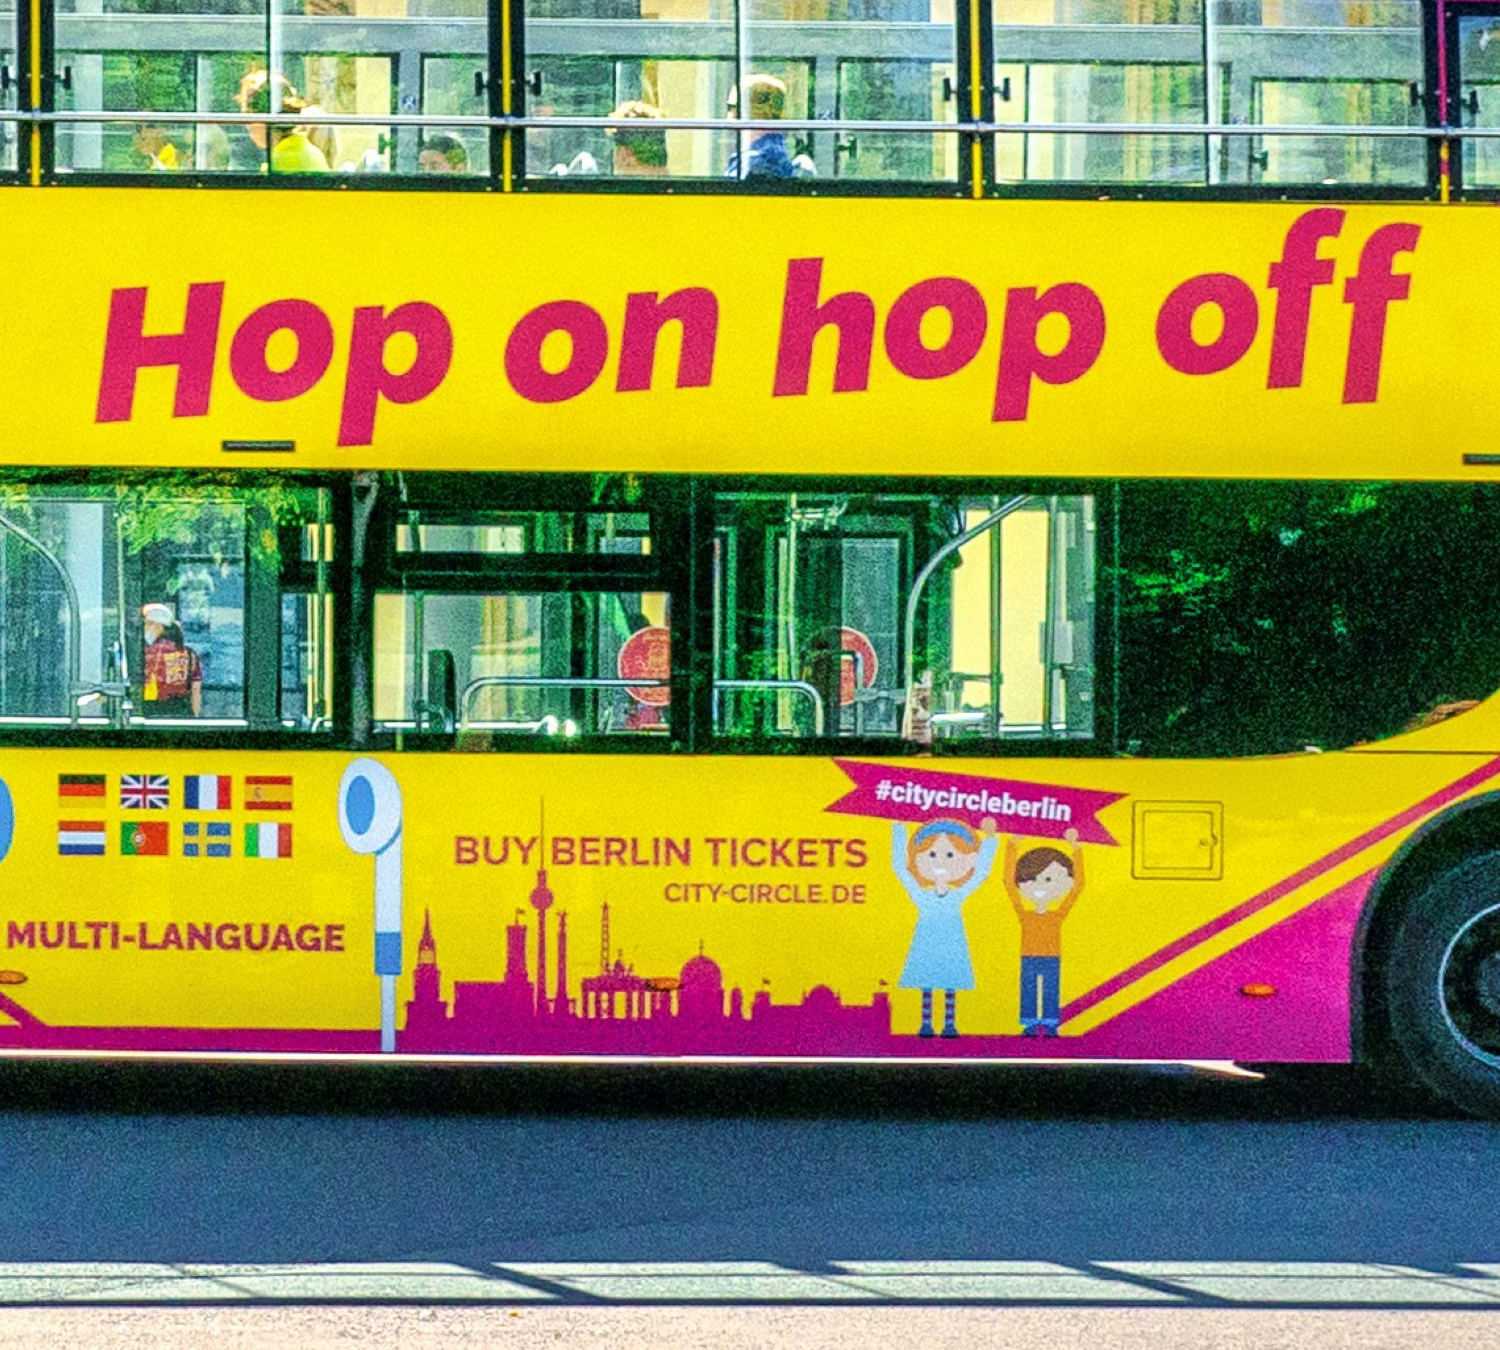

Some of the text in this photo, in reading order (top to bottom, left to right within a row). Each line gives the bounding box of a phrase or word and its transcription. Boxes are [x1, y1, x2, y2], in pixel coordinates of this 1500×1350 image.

[95, 207, 1423, 447] Hop on hop off
[875, 780, 1071, 822] #citycircleberlin
[454, 836, 868, 868] BUY BERLIN TICKETS
[664, 882, 867, 905] CITY-CIRCLE.DE
[6, 921, 346, 952] MULTI-LANGUAGE
